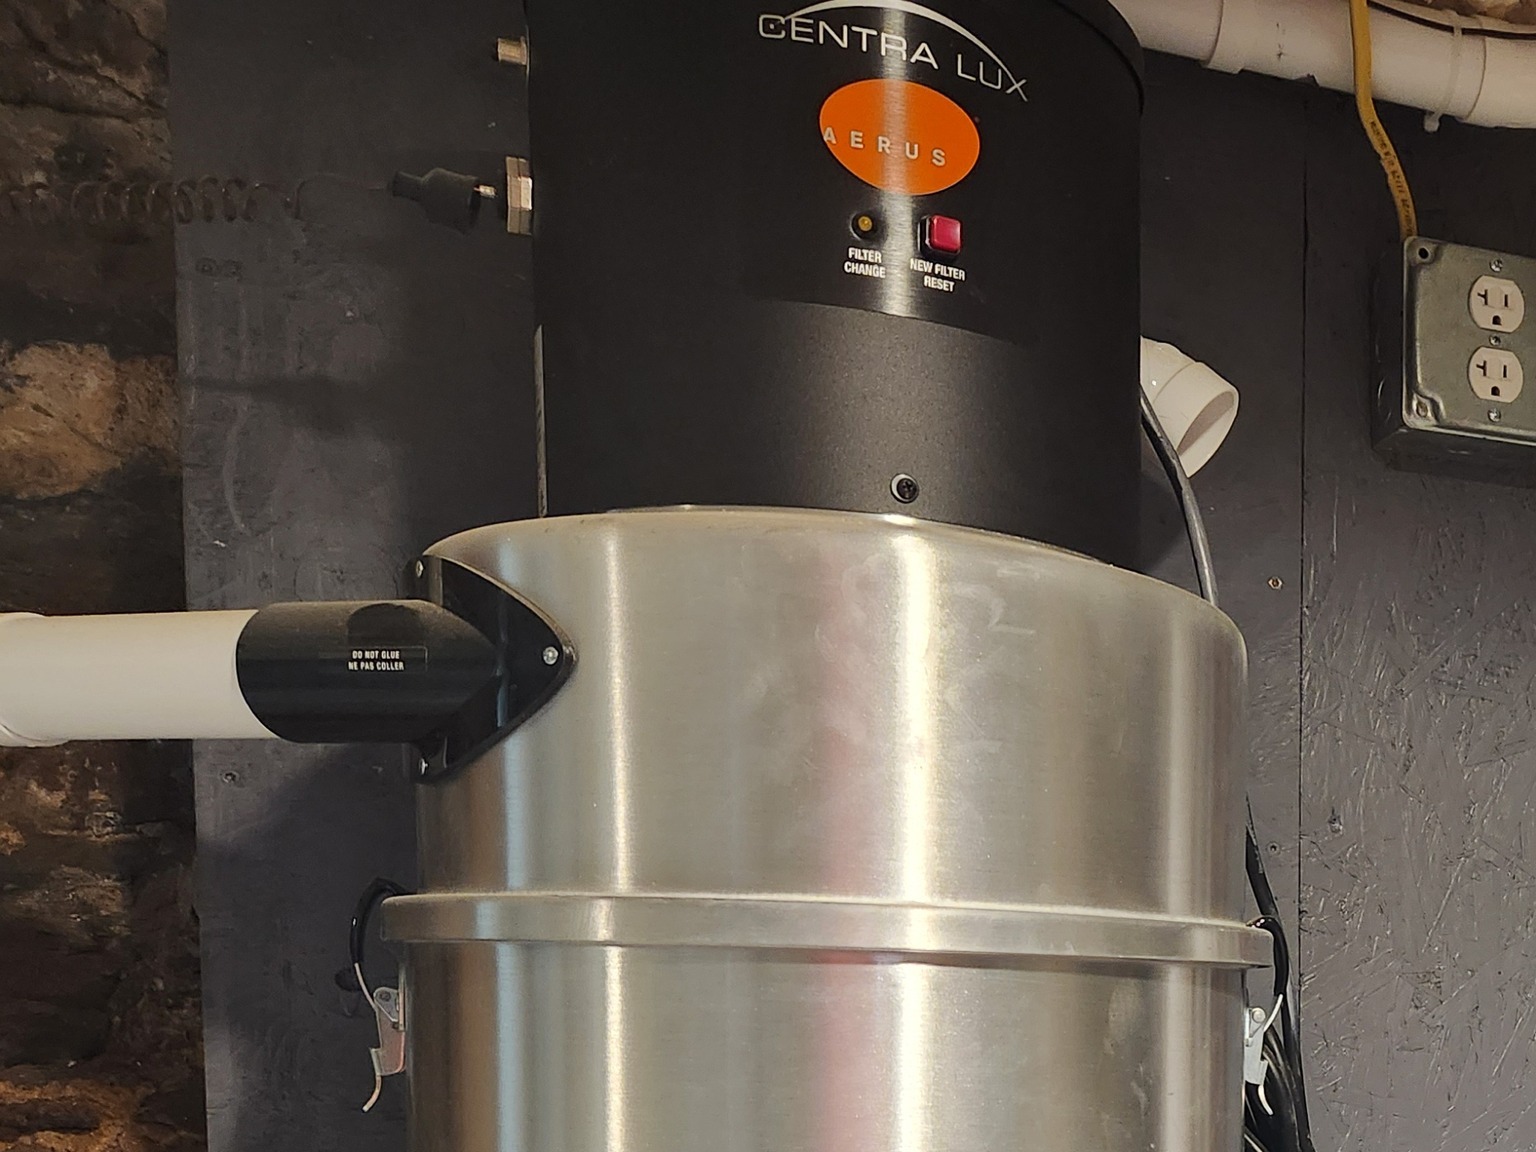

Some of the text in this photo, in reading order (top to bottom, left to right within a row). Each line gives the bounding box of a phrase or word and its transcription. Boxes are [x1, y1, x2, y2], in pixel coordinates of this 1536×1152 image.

[758, 14, 1028, 101] CENTRA LUX
[823, 127, 946, 167] AERUS
[848, 248, 882, 264] FILTER
[844, 262, 886, 279] CHANGE
[910, 258, 966, 281] NEW FILTER
[923, 276, 955, 292] RESET
[352, 650, 400, 659] DO NOT GLUE
[348, 662, 405, 671] NE PAS COLLER
